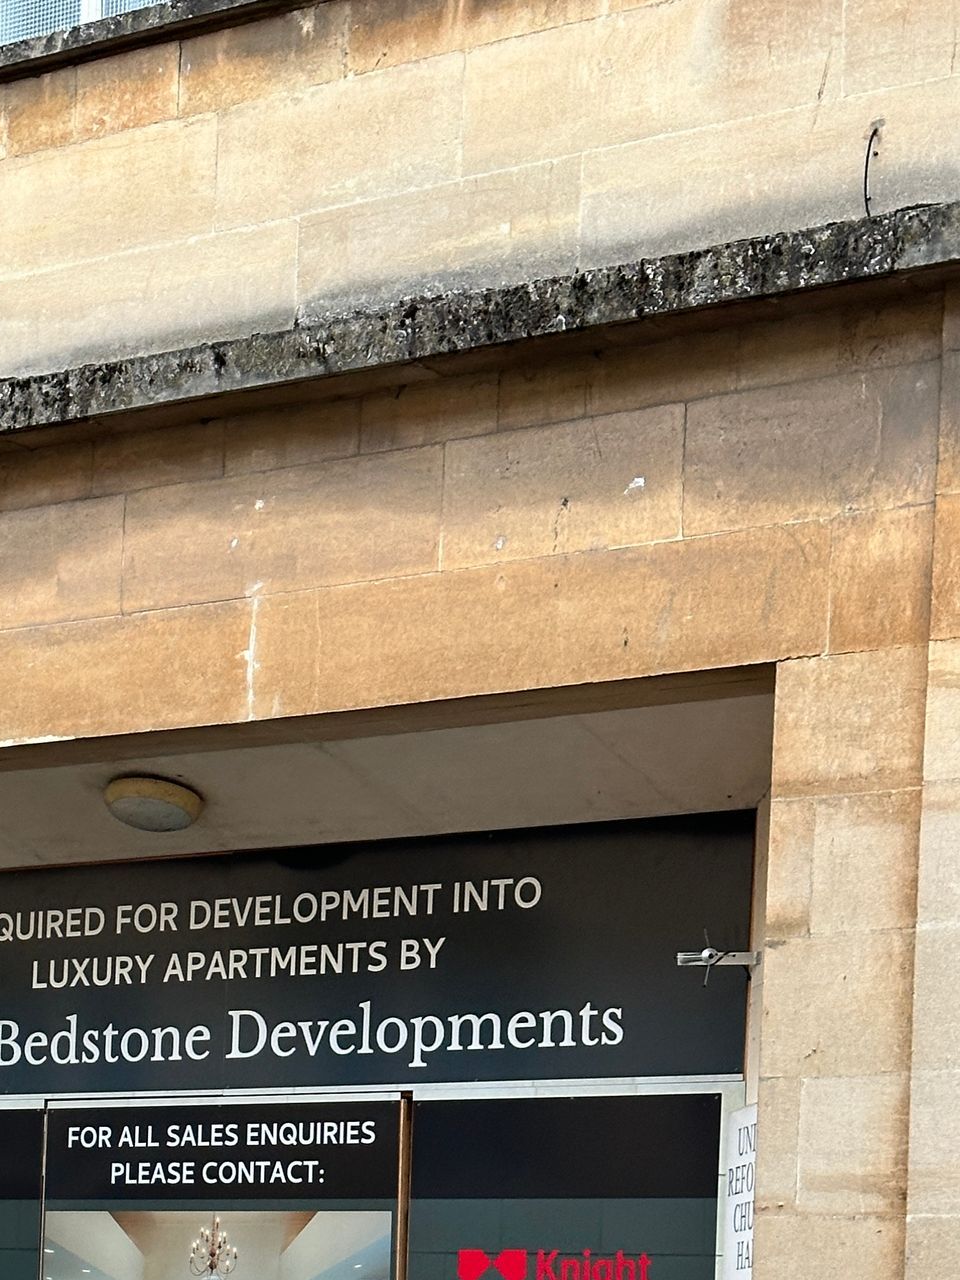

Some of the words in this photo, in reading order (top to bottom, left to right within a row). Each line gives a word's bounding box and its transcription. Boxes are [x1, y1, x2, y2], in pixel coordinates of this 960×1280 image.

[116, 902, 178, 934] FOR
[189, 883, 442, 930] DEVELOPMENT
[452, 876, 542, 913] INTO
[31, 954, 155, 989] LUXURY
[162, 941, 388, 983] APARTMENTS
[400, 937, 446, 970] BY
[225, 1001, 624, 1067] Developments
[67, 1126, 112, 1148] FOR
[118, 1125, 160, 1148] ALL
[166, 1123, 239, 1147] SALES
[246, 1121, 376, 1146] ENQUIRIES
[738, 1123, 756, 1156] UNI
[110, 1161, 195, 1185] PLEASE
[202, 1160, 325, 1184] CONTACT:
[727, 1162, 754, 1197] REFO
